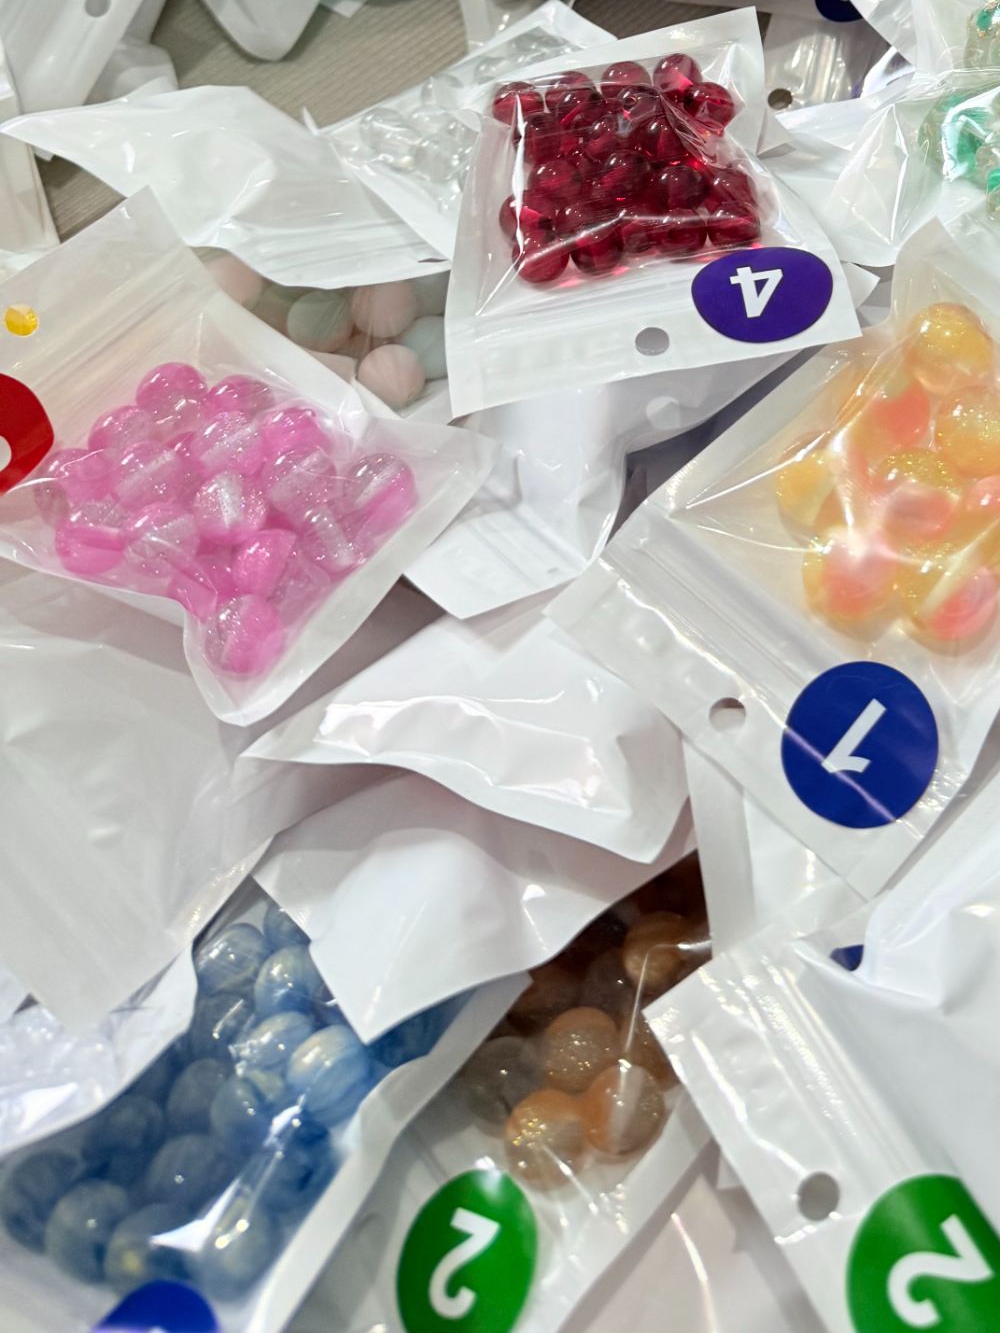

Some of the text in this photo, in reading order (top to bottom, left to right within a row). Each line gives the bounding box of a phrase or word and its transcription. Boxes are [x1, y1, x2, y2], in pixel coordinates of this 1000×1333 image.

[730, 266, 783, 318] 4
[820, 698, 887, 774] 1
[429, 1207, 500, 1319] 2
[887, 1213, 994, 1329] 2
